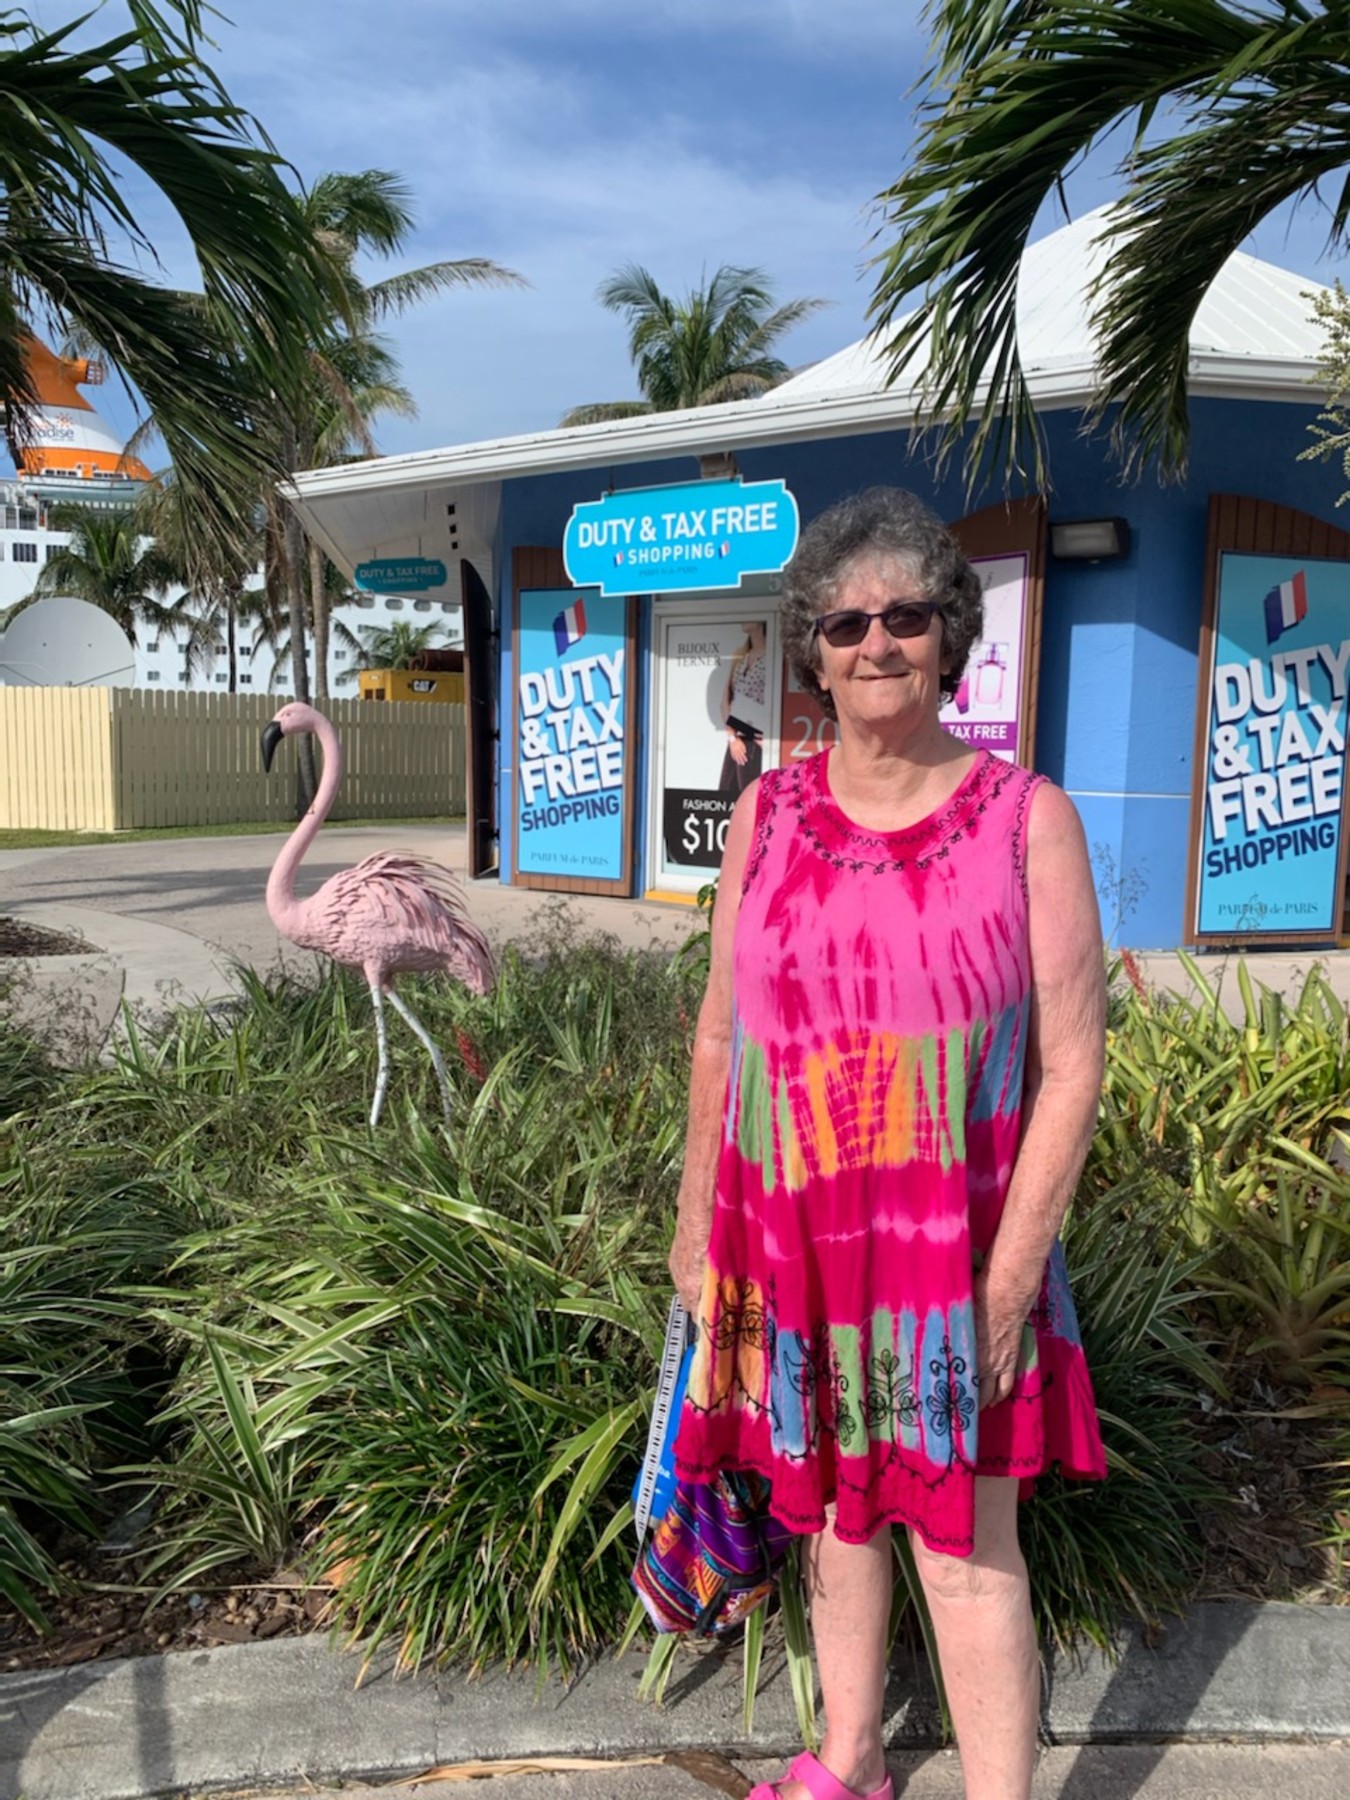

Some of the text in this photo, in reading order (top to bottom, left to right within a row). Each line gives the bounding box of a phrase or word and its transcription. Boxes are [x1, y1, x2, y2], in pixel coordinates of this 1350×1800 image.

[578, 502, 778, 548] DUTY & TAX FREE
[628, 542, 715, 564] SHOPPING
[360, 565, 440, 578] DUTY & TAX FREE
[677, 642, 720, 655] BIJOUX
[676, 656, 721, 667] TERNER
[413, 680, 430, 692] CAT
[519, 649, 625, 718] DUTY
[1214, 639, 1350, 724] DUTY
[947, 725, 1008, 739] TAX FREE
[519, 742, 623, 806] FREE
[682, 798, 727, 811] FASHION
[1208, 755, 1342, 841] FREE
[521, 794, 620, 832] SHOPPING
[1206, 822, 1335, 878] SHOPPING
[581, 855, 609, 865] PARIS
[1285, 902, 1318, 914] PARIS
